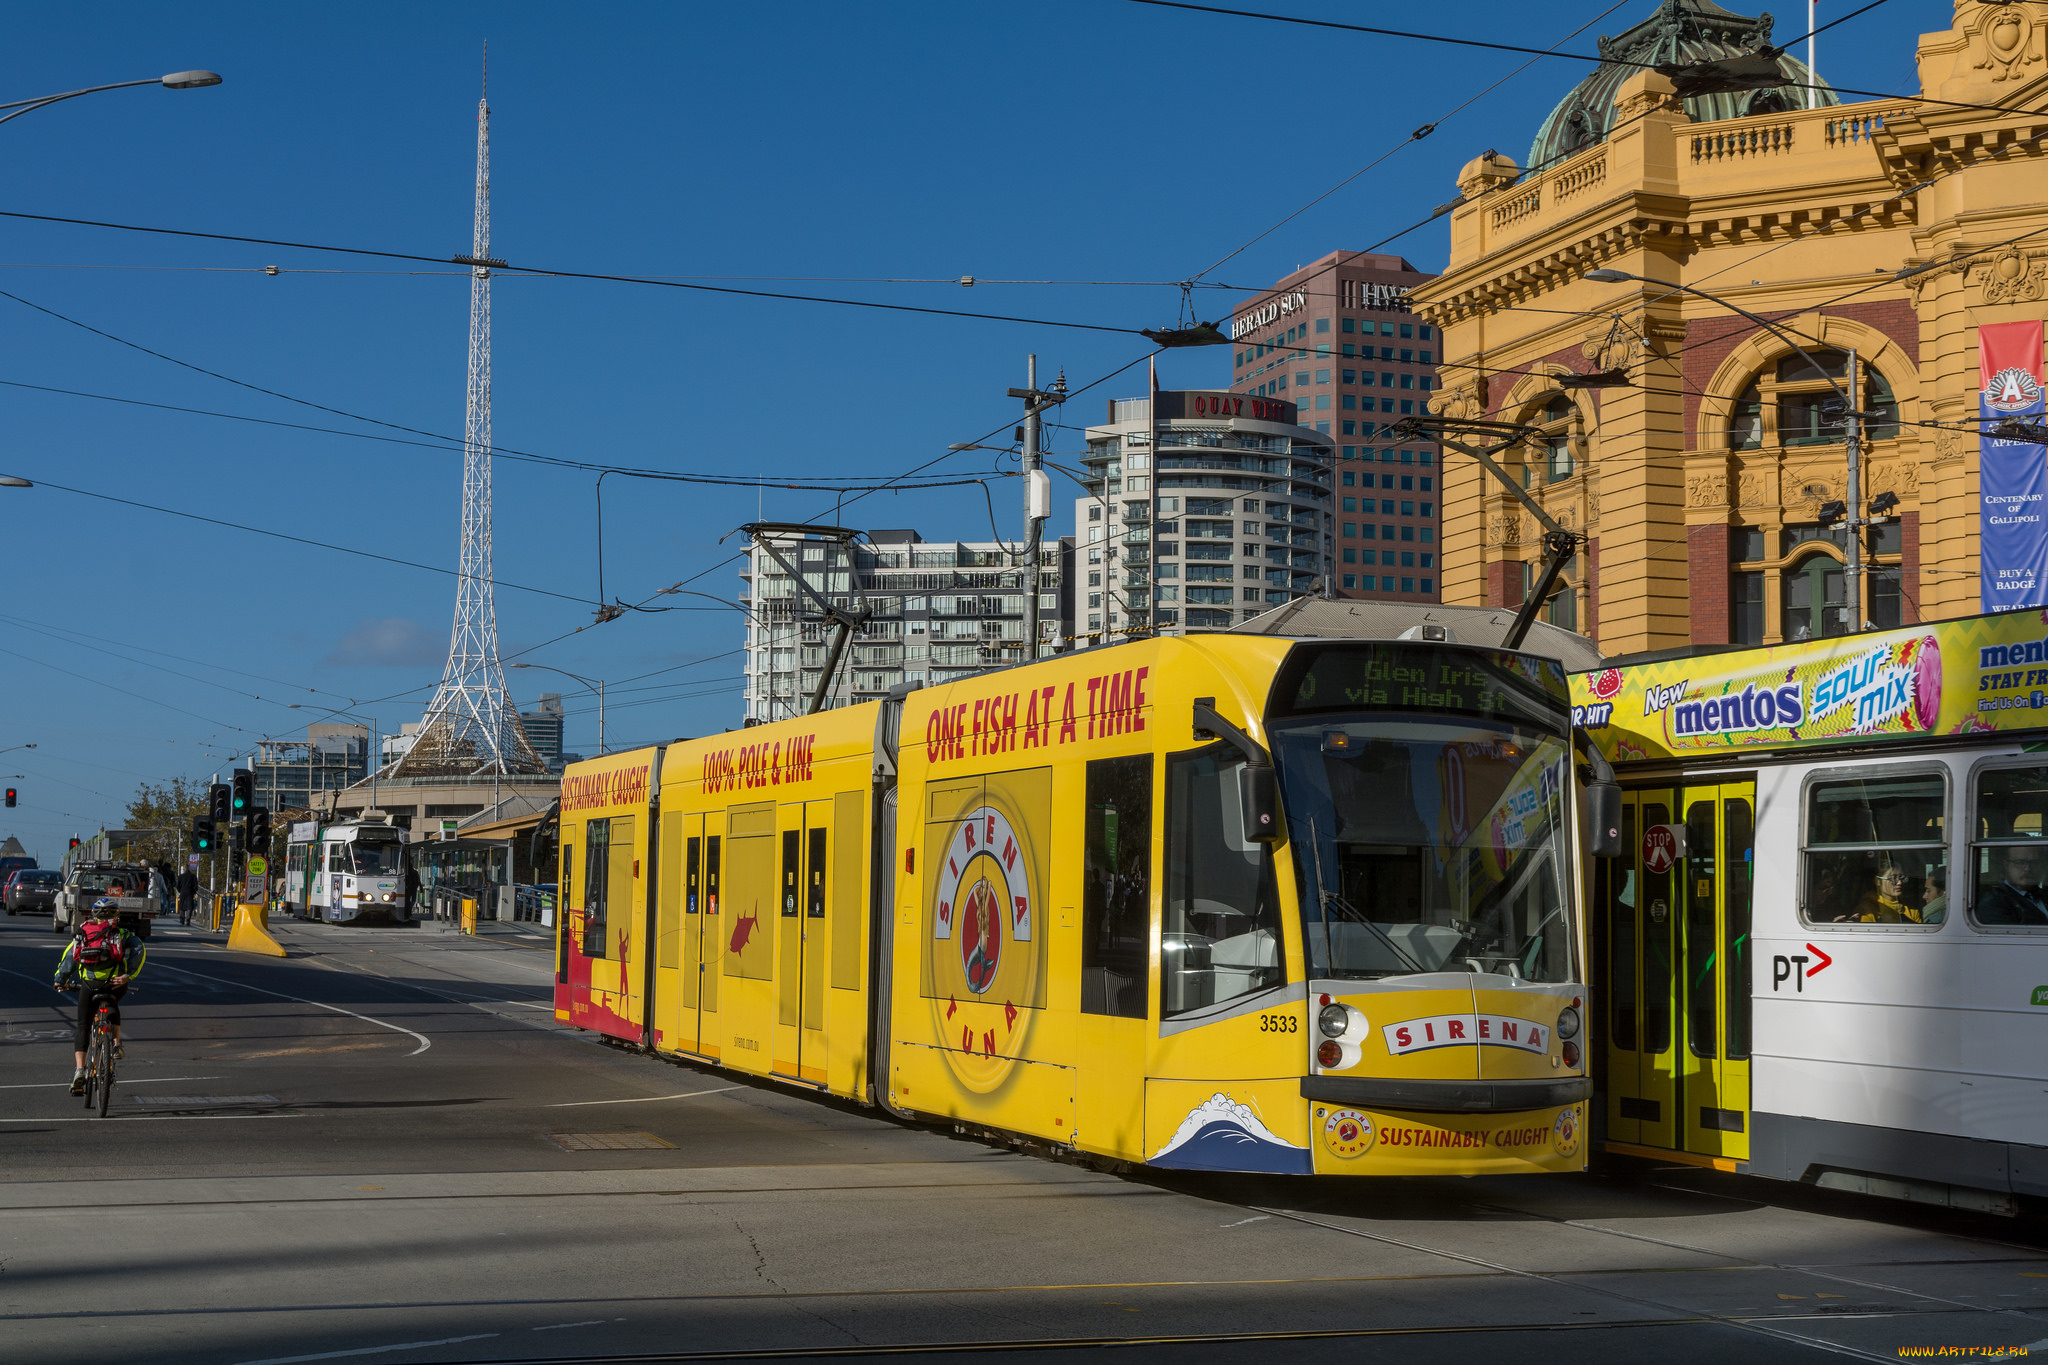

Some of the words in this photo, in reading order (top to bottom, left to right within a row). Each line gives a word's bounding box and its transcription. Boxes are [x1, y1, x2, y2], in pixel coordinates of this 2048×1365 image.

[1231, 303, 1278, 341] HERALD
[1281, 288, 1307, 316] SUN
[1195, 396, 1241, 417] QUAY
[1251, 399, 1286, 422] WEST
[1985, 493, 2043, 504] CENTENARY
[2007, 505, 2021, 513] OF
[1989, 514, 2040, 525] GALLIPOLI
[1995, 580, 2036, 590] BADGE
[1999, 569, 2023, 578] BUY
[2025, 568, 2033, 577] A
[1364, 660, 1426, 684] Glen
[1440, 665, 1489, 688] Iris
[1813, 650, 1885, 715] sour
[1979, 671, 2024, 691] STAY
[1345, 684, 1388, 705] via
[1403, 686, 1463, 709] High
[1478, 690, 1505, 711] St
[1644, 679, 1689, 716] New
[1675, 683, 1802, 735] mentos
[1858, 671, 1910, 725] mix
[1978, 697, 1998, 711] Find
[2000, 696, 2012, 709] Us
[2014, 695, 2029, 708] On
[926, 702, 968, 764] ONE
[972, 693, 1019, 757] FISH
[1023, 685, 1056, 750] AT
[1059, 681, 1077, 745] A
[1086, 666, 1149, 740] TIME
[1587, 703, 1612, 727] HIT
[702, 748, 735, 795] 100%
[738, 742, 770, 790] POLE
[771, 741, 782, 786] &
[785, 733, 816, 784] LINE
[560, 771, 611, 813] SUSTAINABLY
[612, 765, 649, 807] CAUGHT
[1646, 833, 1671, 848] STOP
[939, 814, 1028, 926] SIRENA
[946, 993, 1018, 1061] TUNA
[1259, 1014, 1298, 1034] 3533
[1395, 1019, 1542, 1048] SIRENA
[1327, 1111, 1370, 1131] SIRENA
[1331, 1140, 1366, 1153] TUNA
[1379, 1126, 1491, 1149] SUSTAINABLY
[1494, 1126, 1550, 1147] CAUGHT
